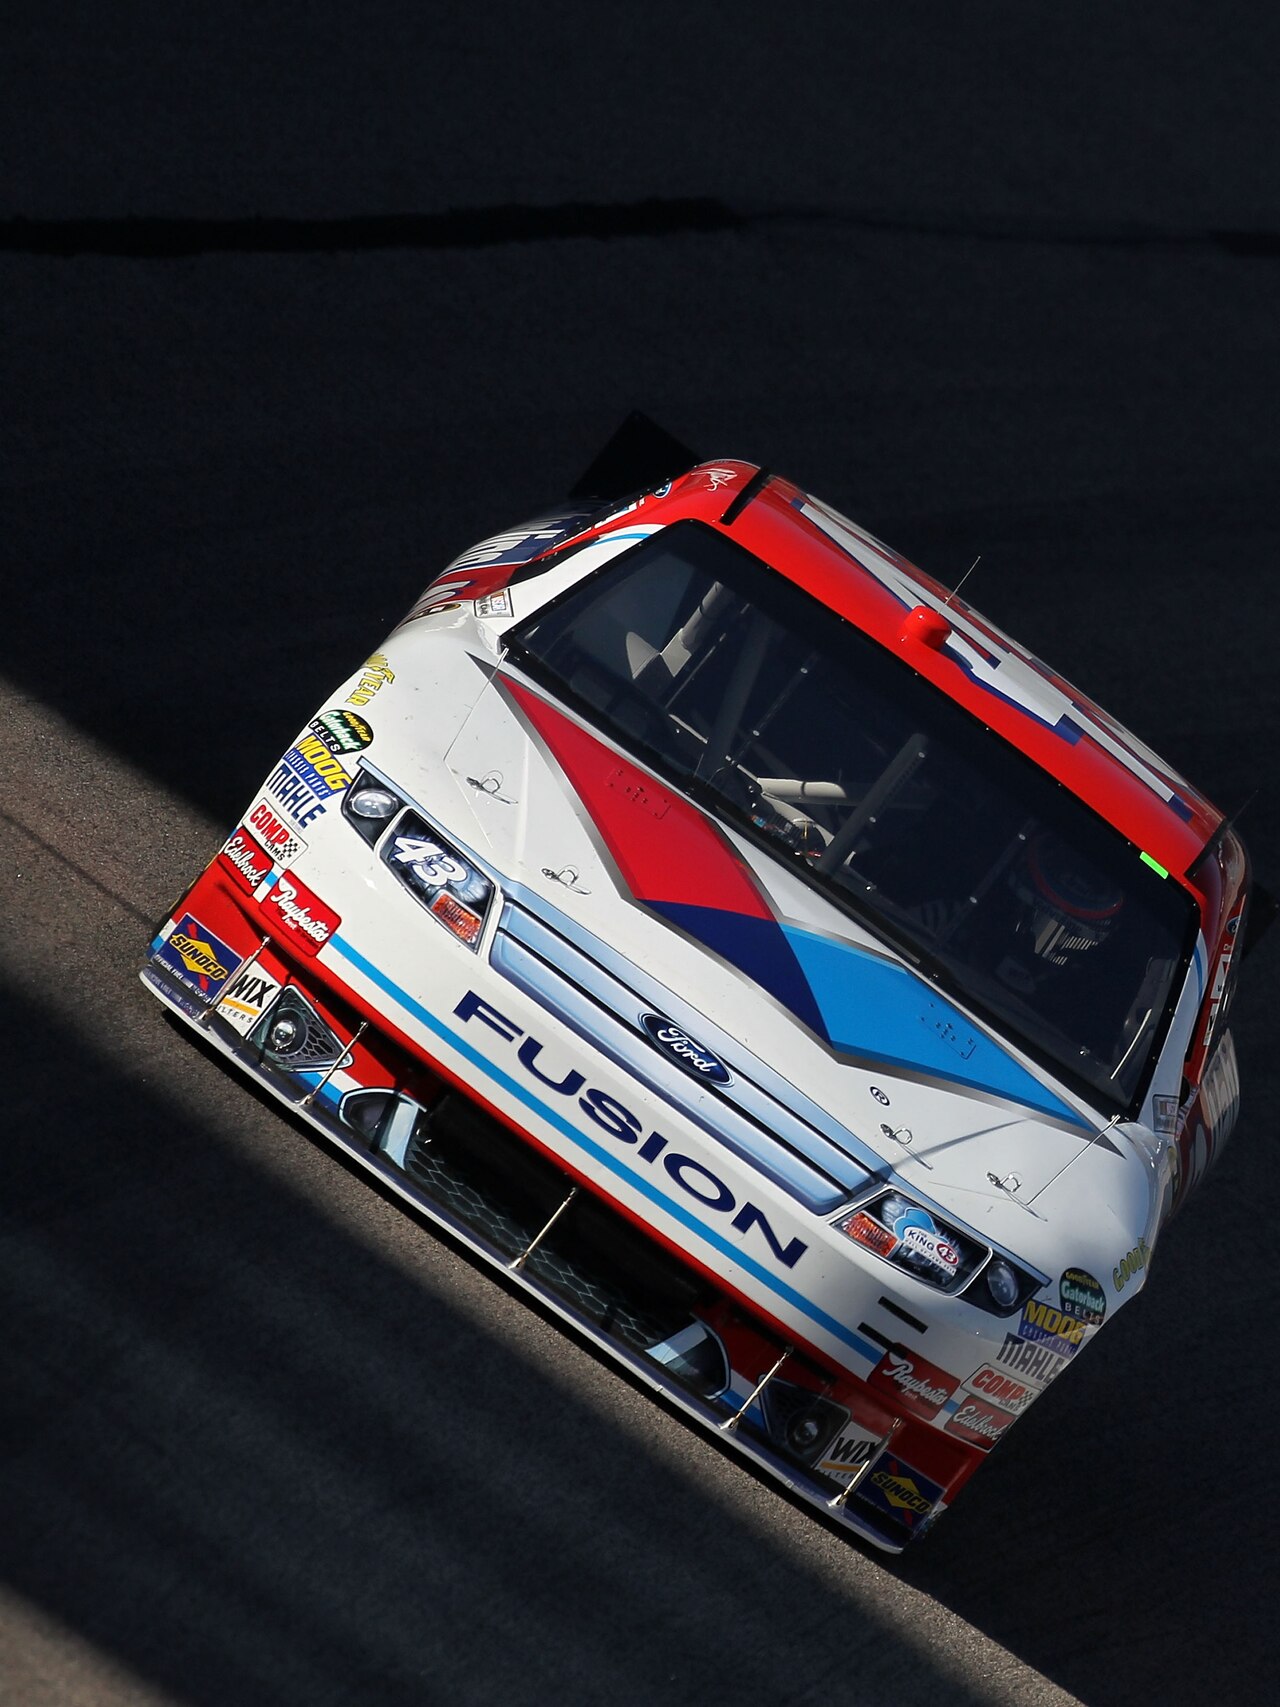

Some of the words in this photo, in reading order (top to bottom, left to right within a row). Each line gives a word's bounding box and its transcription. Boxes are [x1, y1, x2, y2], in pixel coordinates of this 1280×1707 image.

[309, 721, 341, 752] BELTS
[295, 734, 353, 791] MOOG
[265, 762, 327, 829] MAHLE
[249, 804, 290, 845] COMP
[223, 836, 268, 887] Edelbrock
[264, 839, 286, 862] CAMS
[394, 836, 468, 886] 43
[270, 876, 330, 942] Raybestos
[171, 935, 226, 979] SUNOCO
[657, 1026, 718, 1074] Ford
[452, 989, 809, 1270] FUSION
[908, 1230, 935, 1251] KING
[938, 1245, 956, 1263] 43
[1023, 1301, 1086, 1346] MOOG
[1064, 1302, 1101, 1324] BELTS
[881, 1351, 949, 1406] Raybestos
[996, 1332, 1064, 1383] MAHLE
[972, 1369, 1026, 1401] COMP
[953, 1405, 1007, 1441] Edelbrock
[874, 1473, 931, 1513] SUNOCO
